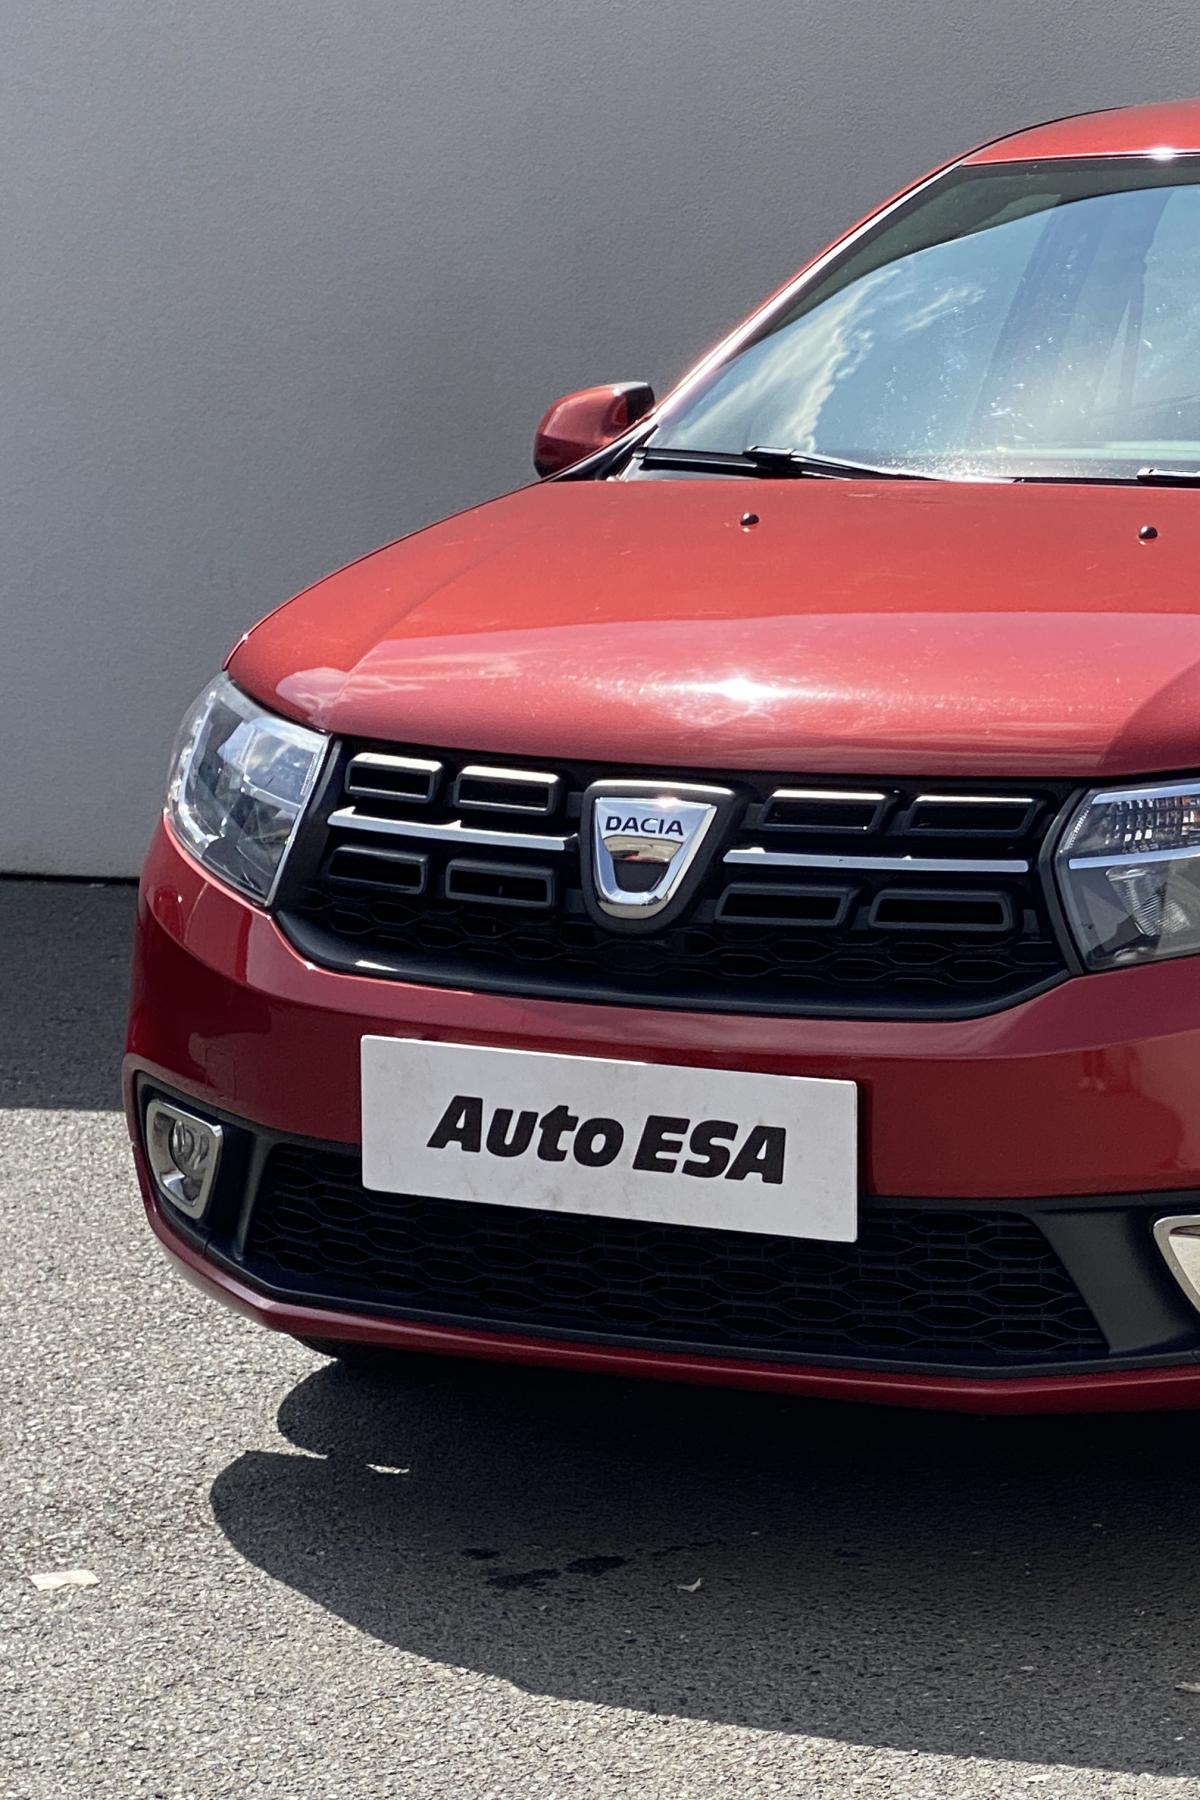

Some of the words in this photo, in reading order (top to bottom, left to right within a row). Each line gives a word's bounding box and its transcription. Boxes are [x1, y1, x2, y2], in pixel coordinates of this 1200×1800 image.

[605, 815, 684, 836] DACIA
[426, 1095, 625, 1168] Auto
[632, 1114, 787, 1185] ESA
